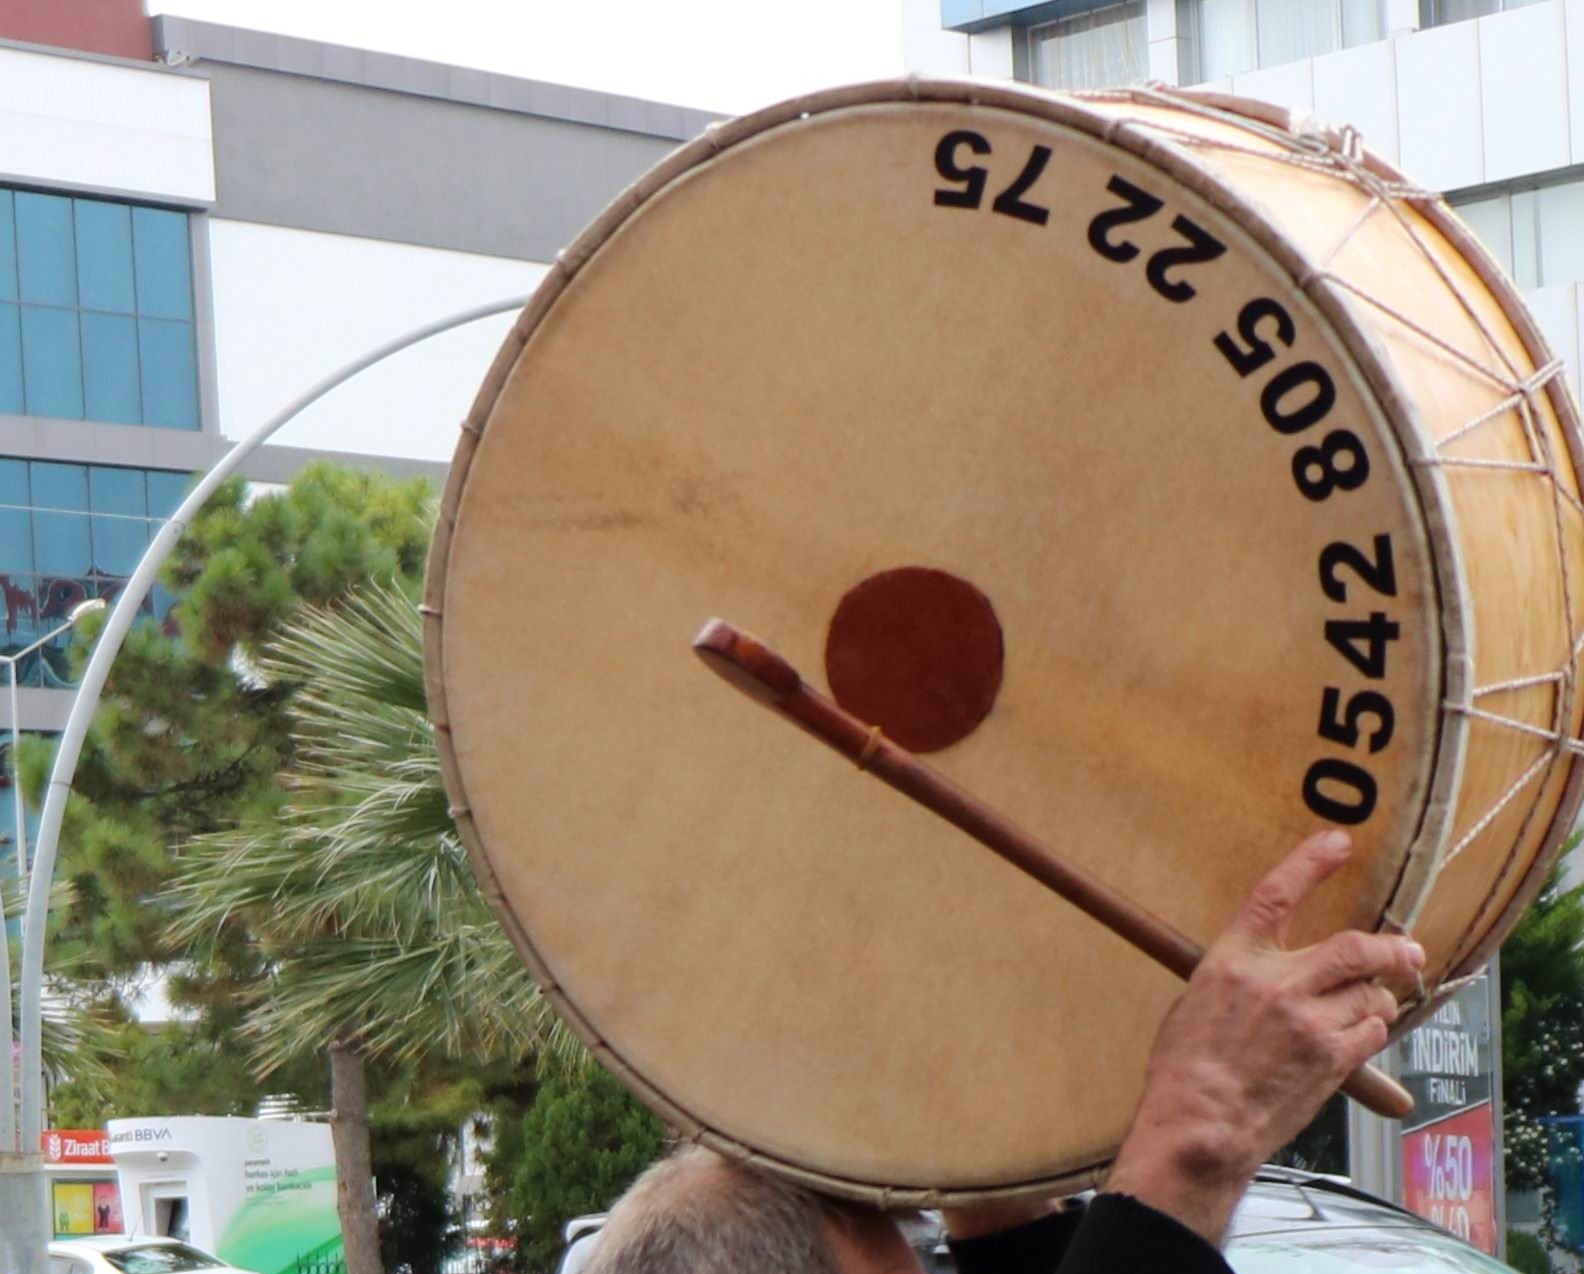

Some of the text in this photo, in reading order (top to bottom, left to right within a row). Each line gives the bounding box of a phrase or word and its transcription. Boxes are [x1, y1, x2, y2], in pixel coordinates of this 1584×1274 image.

[933, 130, 1401, 828] 0542 805 22 75
[63, 1138, 101, 1156] Ziraat
[134, 1127, 172, 1142] BBVA
[1424, 1133, 1473, 1201] %50
